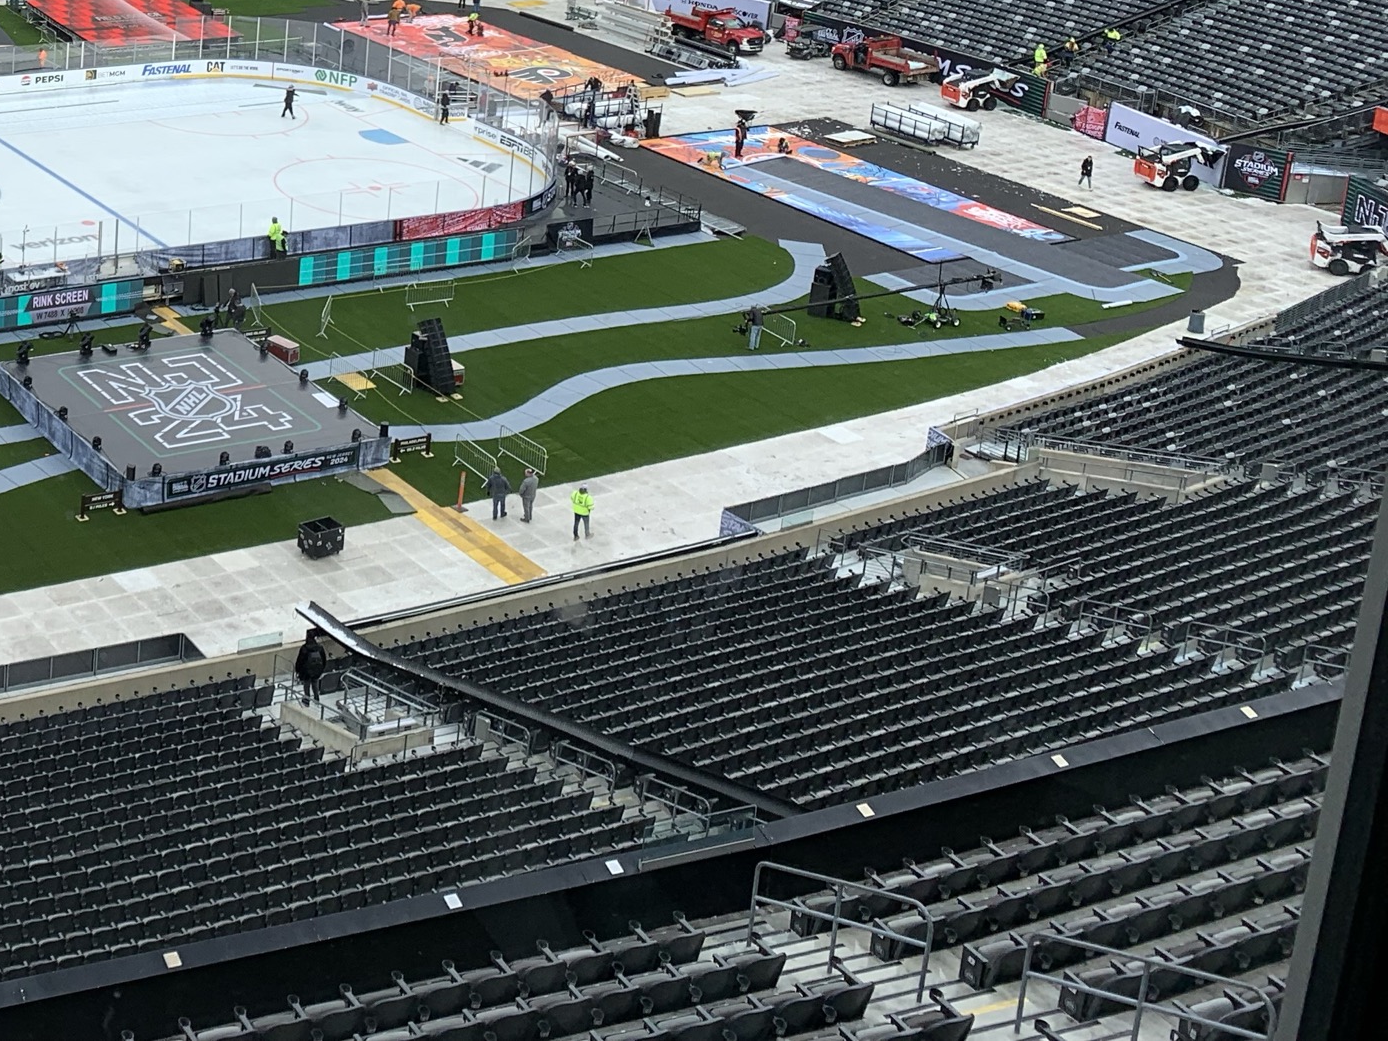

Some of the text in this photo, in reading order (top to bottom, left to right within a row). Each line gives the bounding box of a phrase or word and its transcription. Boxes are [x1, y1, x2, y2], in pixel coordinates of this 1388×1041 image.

[688, 0, 719, 10] HONDA
[142, 64, 192, 76] FASTENAL
[206, 61, 225, 73] CAT
[35, 74, 64, 84] PEPSI
[329, 71, 358, 88] NFP
[1114, 121, 1140, 139] FASTENAL
[500, 135, 523, 153] ESPN
[1234, 159, 1278, 176] STADIUM
[10, 234, 99, 251] verizon
[33, 290, 89, 308] RINK SCREEN
[175, 388, 208, 418] NHL
[330, 457, 349, 466] 2024
[207, 465, 271, 488] STADIUM
[269, 456, 325, 475] SERIES
